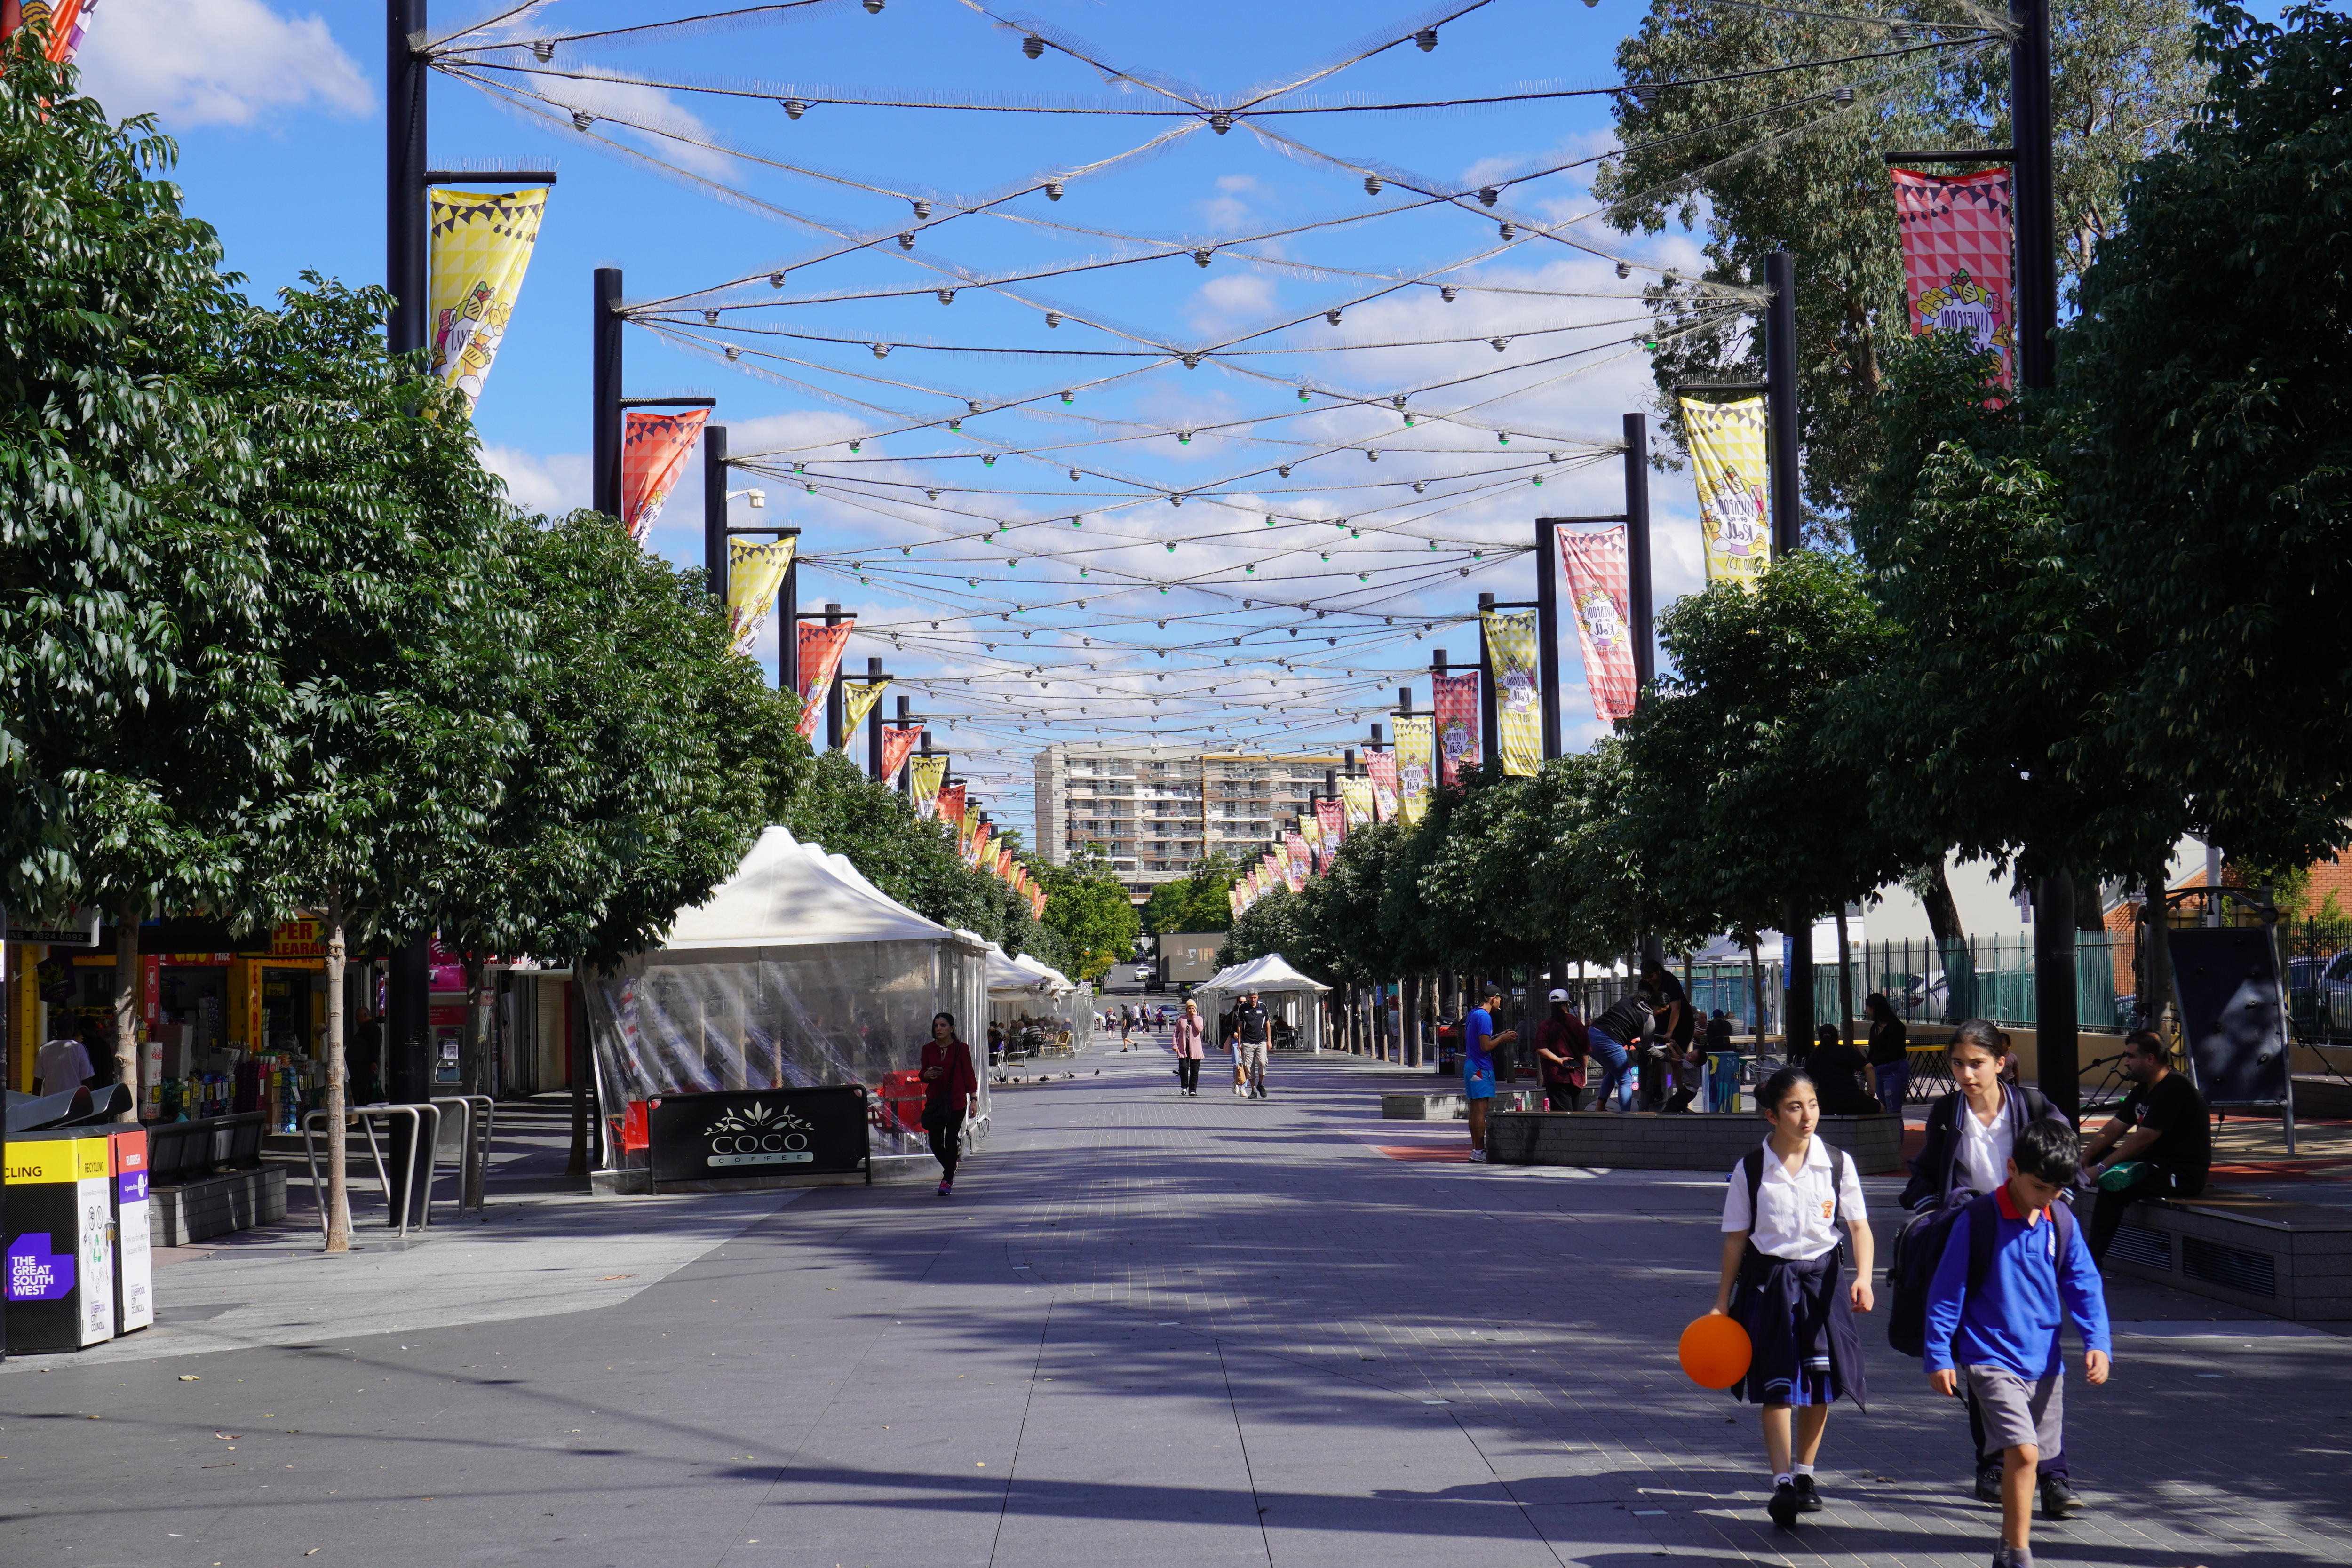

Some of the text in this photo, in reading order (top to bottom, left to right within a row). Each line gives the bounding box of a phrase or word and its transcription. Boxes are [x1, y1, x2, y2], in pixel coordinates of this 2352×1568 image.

[274, 923, 312, 939] PER
[712, 1133, 807, 1154] COCO
[126, 1154, 141, 1166] RUBBISH
[718, 1154, 803, 1163] COFFEE
[5, 1166, 42, 1178] LING
[85, 1162, 104, 1173] RECYCLING
[12, 1256, 36, 1266] THE
[13, 1265, 51, 1276] GREAT
[13, 1275, 54, 1286] SOUTH
[13, 1285, 46, 1296] WEST
[131, 1286, 145, 1297] LIVERPOOL
[91, 1303, 105, 1314] LIVERPOOL
[132, 1304, 143, 1314] COUNCIL
[91, 1321, 104, 1332] COUNCIL
